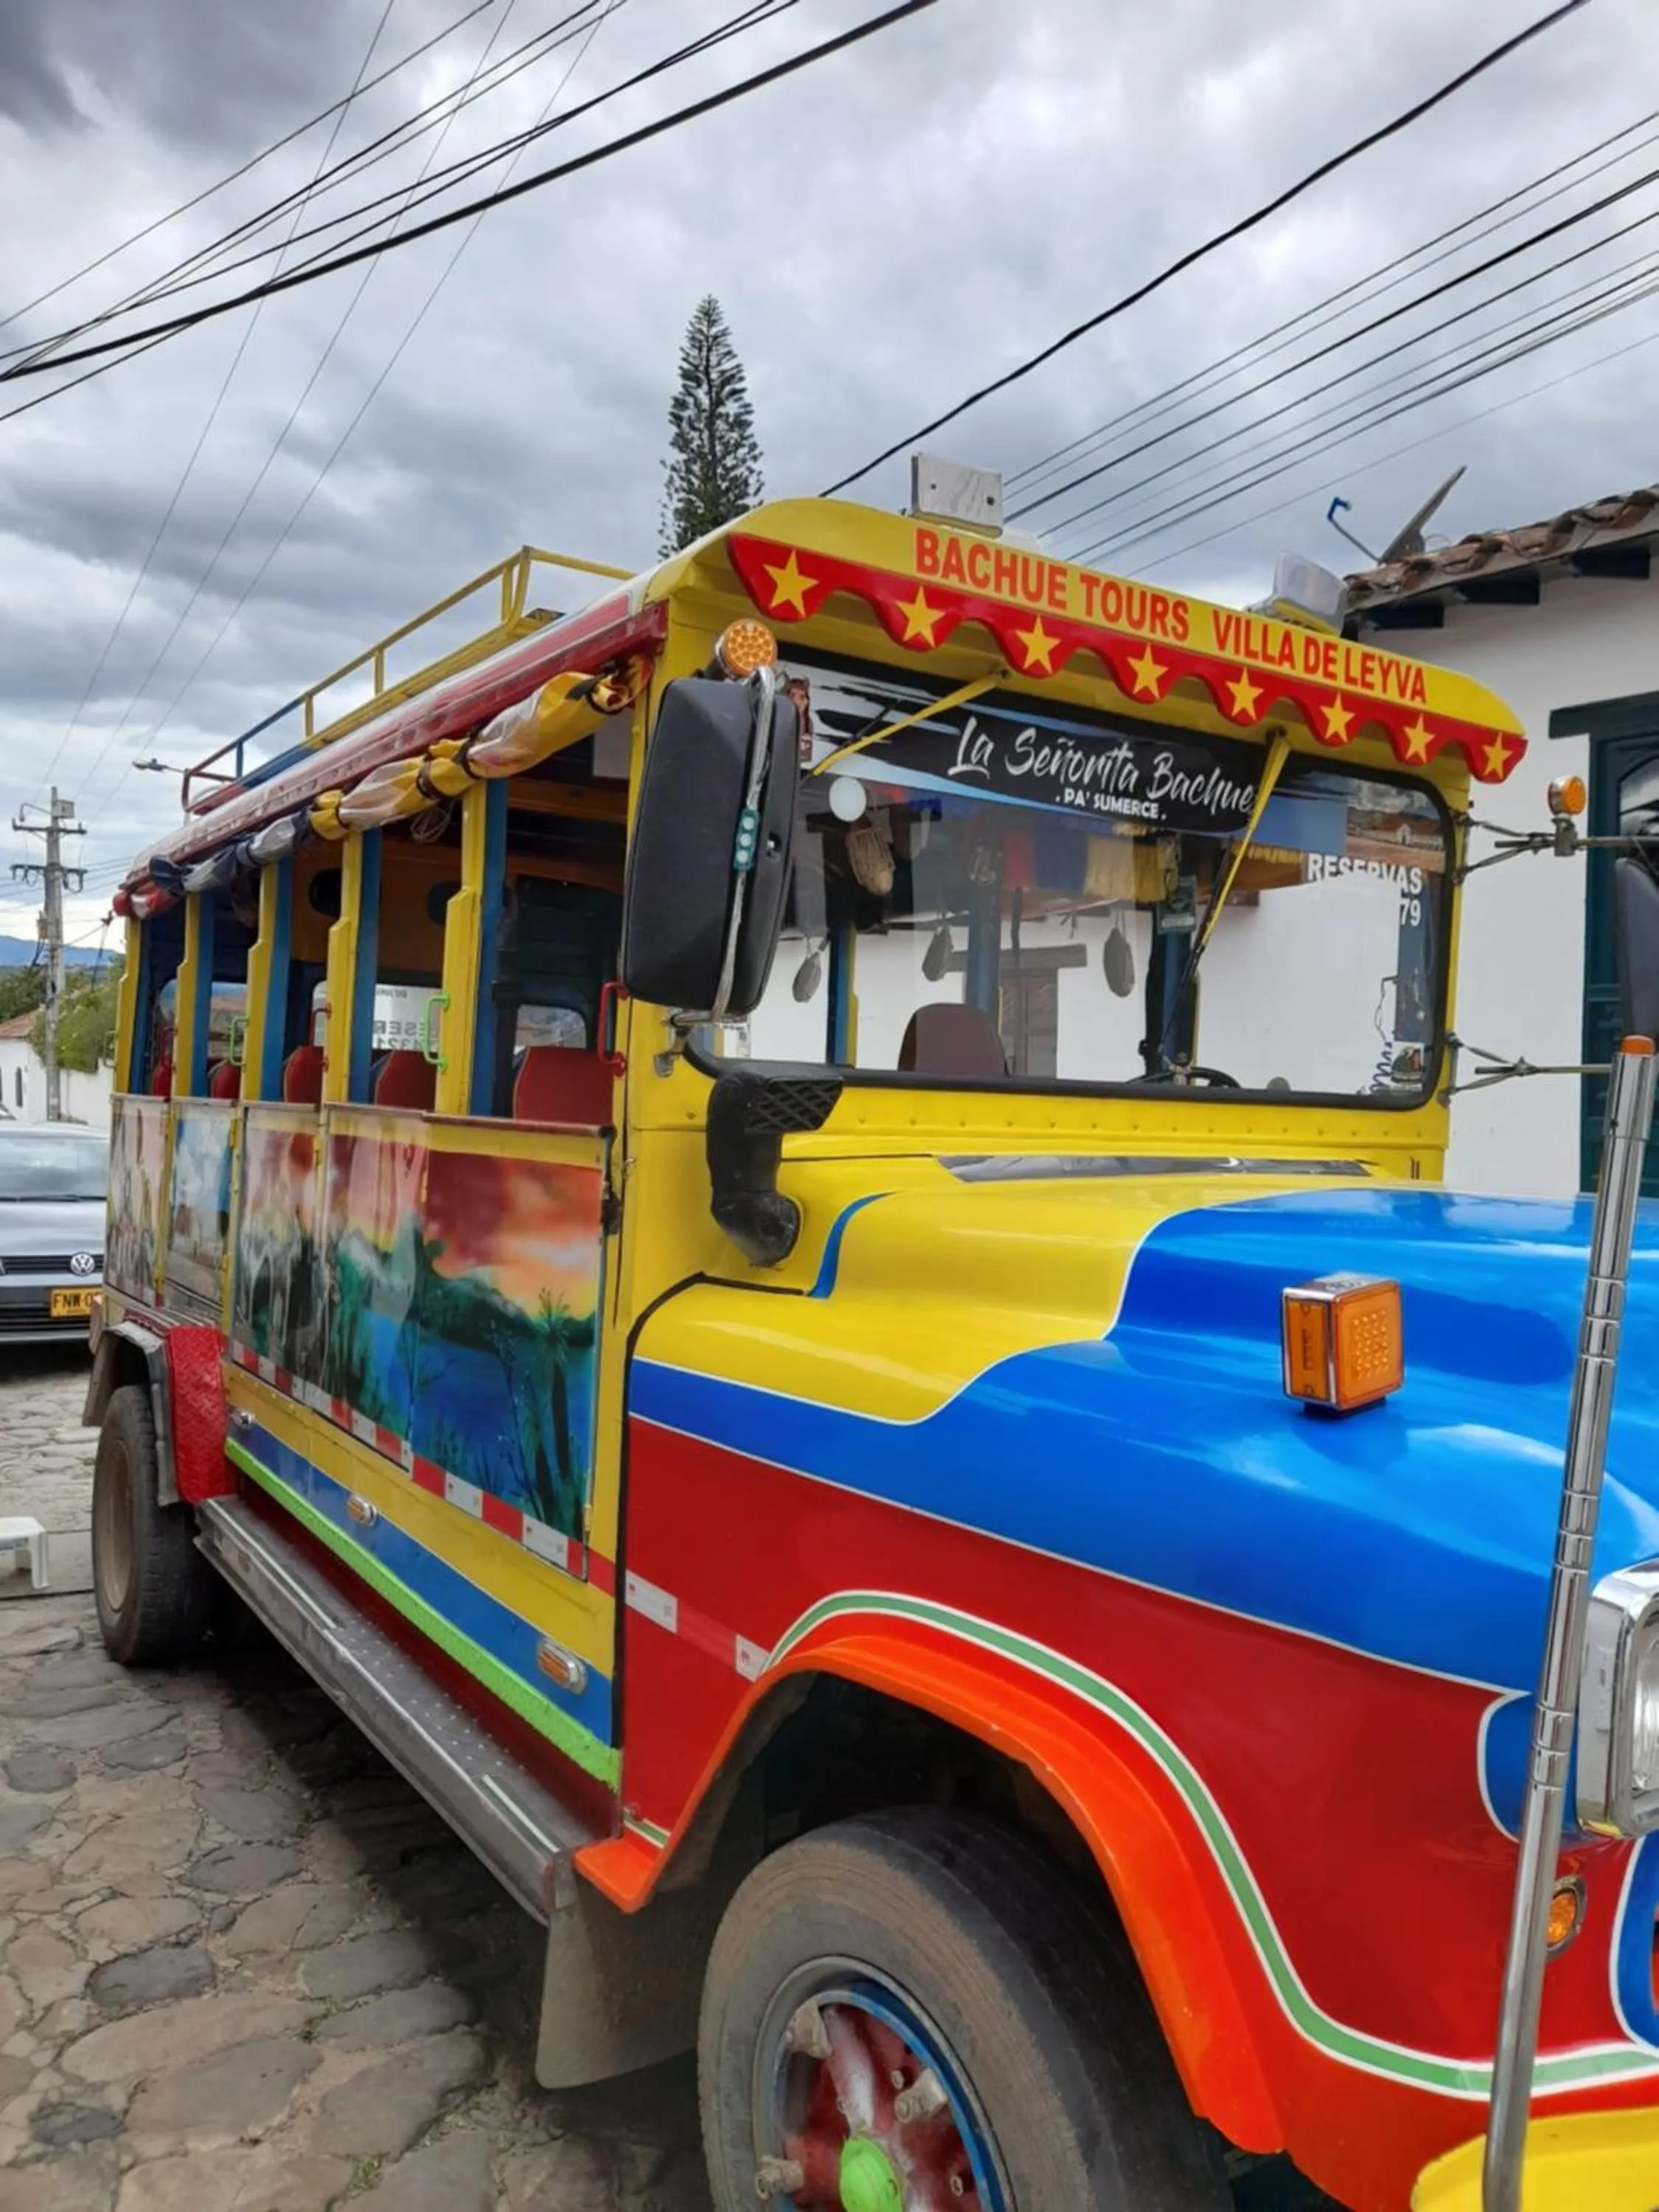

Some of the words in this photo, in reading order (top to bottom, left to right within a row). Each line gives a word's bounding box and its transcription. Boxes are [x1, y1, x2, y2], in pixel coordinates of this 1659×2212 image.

[917, 528, 1068, 611] BACHUE
[1079, 574, 1189, 642] TOURS
[1213, 611, 1295, 670] VILLA
[1304, 636, 1338, 681] DE
[1345, 647, 1426, 703] LEYVA
[947, 716, 995, 779] La
[1005, 728, 1139, 793] Señorita
[1147, 752, 1254, 815] Bachue
